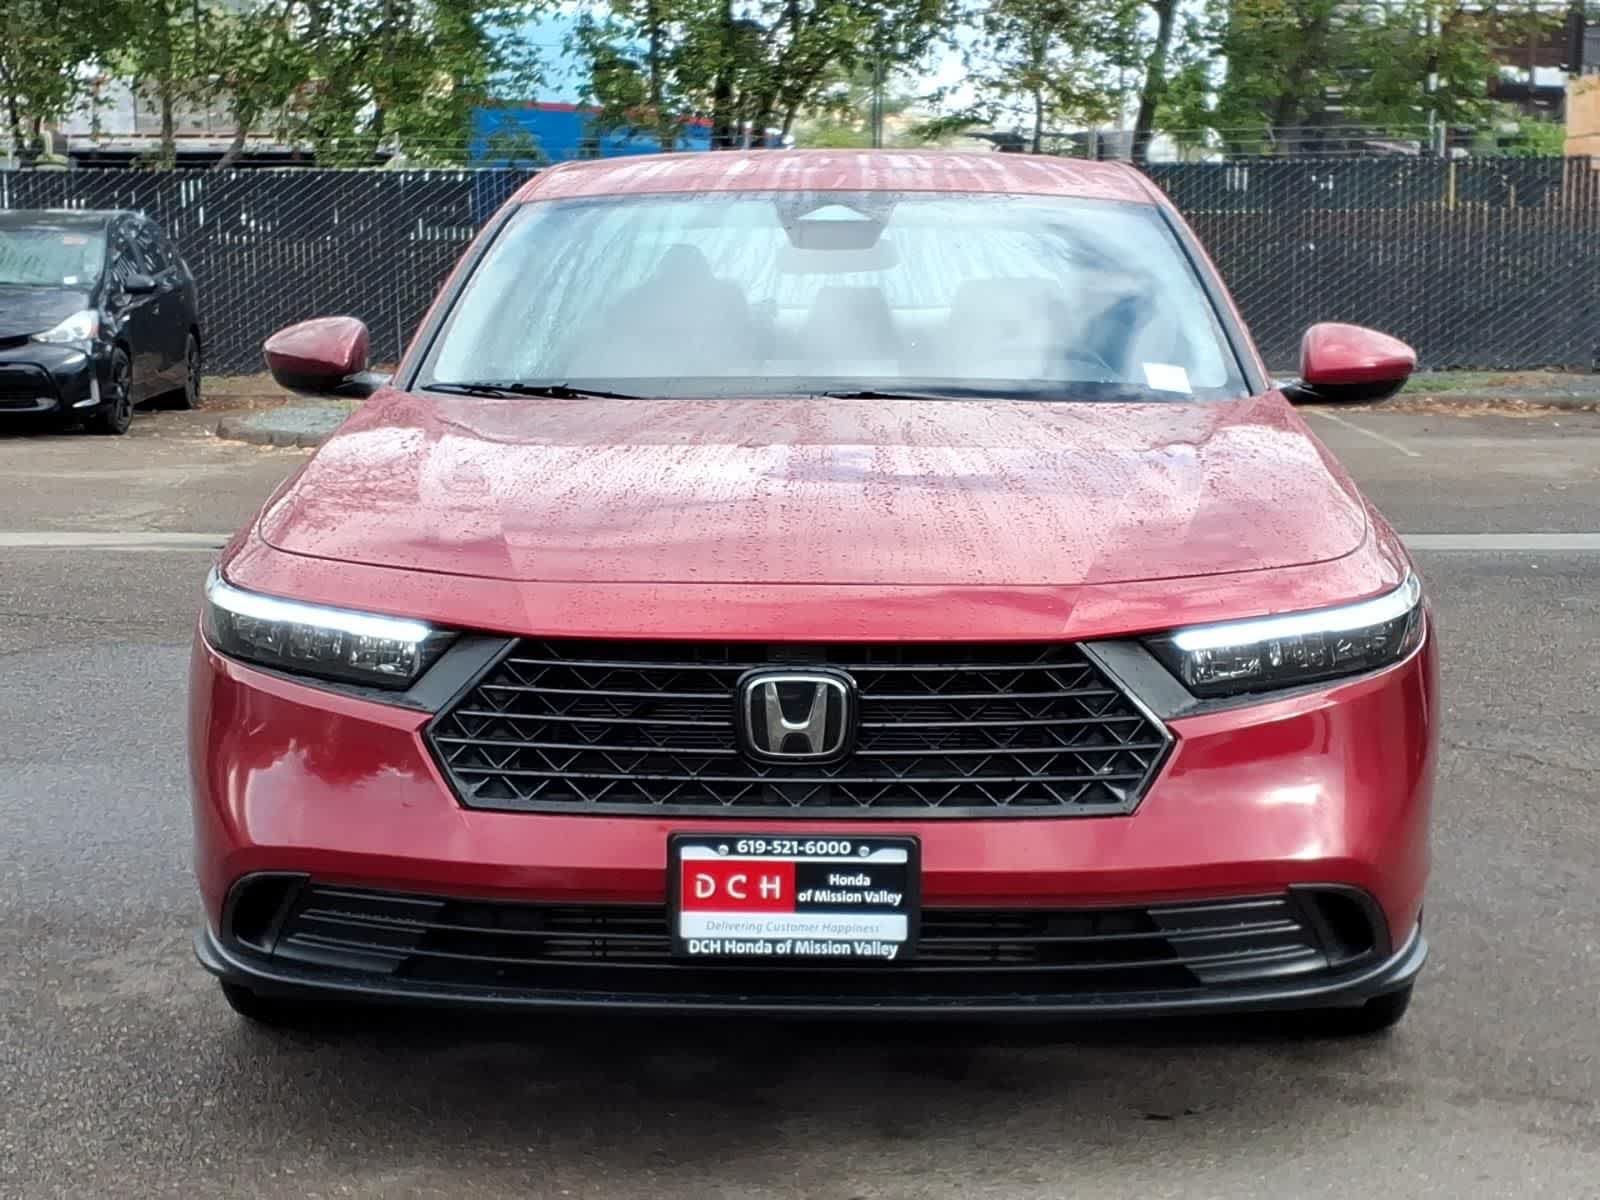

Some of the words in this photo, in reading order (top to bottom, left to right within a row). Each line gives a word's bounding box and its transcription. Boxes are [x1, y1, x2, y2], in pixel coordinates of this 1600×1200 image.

[736, 839, 852, 855] 619-521-6000
[829, 873, 871, 887] Honda
[798, 887, 813, 902] of
[814, 889, 862, 903] Mission
[863, 890, 902, 907] Valley
[705, 919, 763, 933] Delivering
[765, 920, 819, 933] Customer
[688, 939, 721, 954] DCH
[724, 939, 773, 954] Honda
[775, 939, 793, 954] of
[794, 940, 851, 956] Mission
[853, 941, 899, 960] Valley
